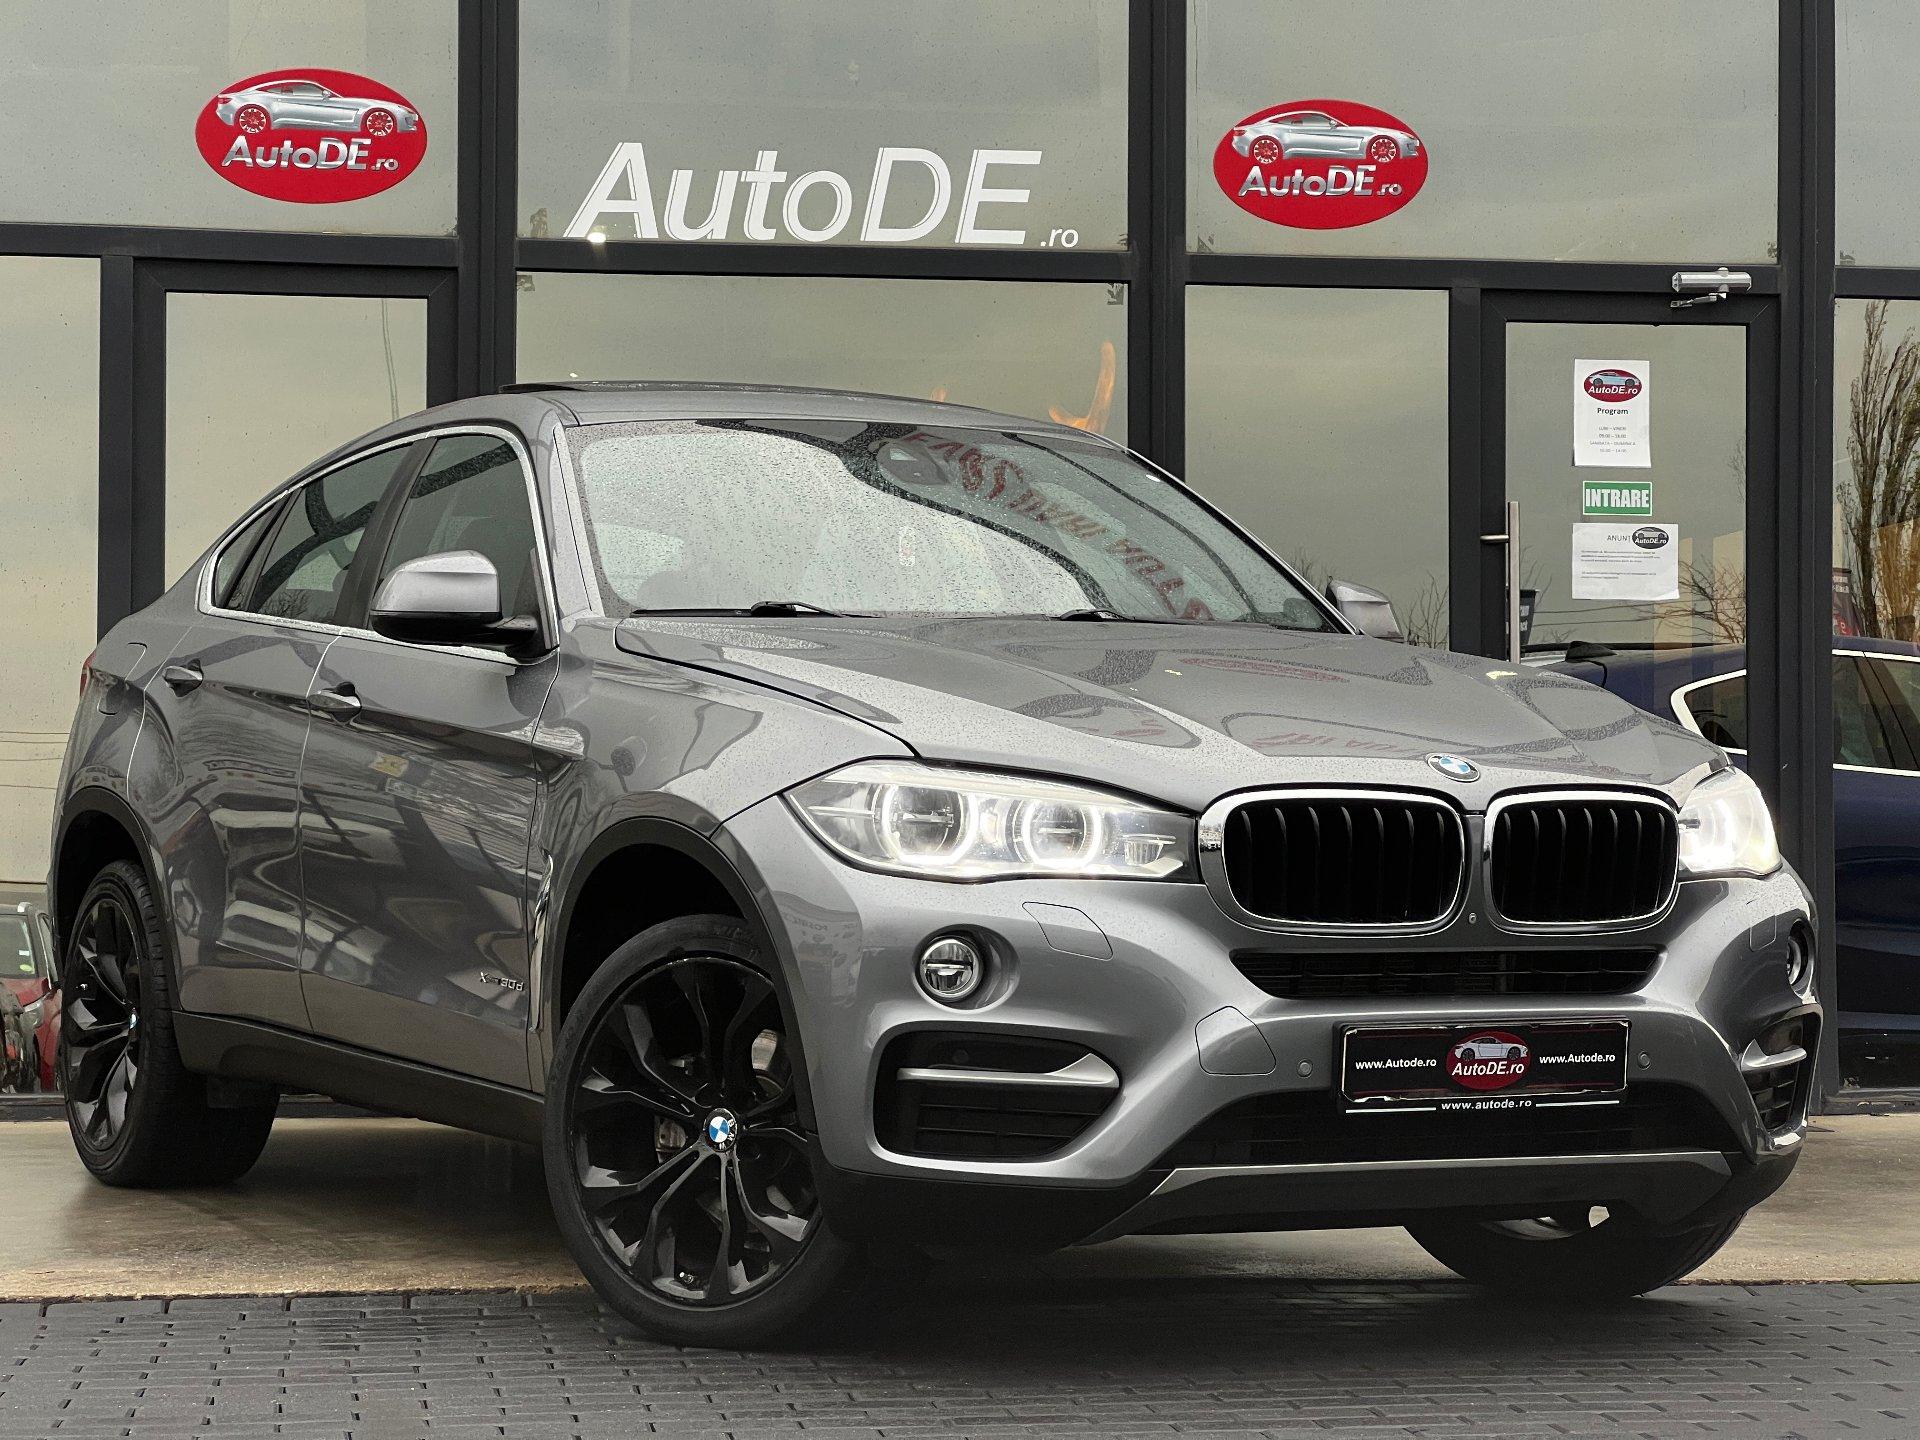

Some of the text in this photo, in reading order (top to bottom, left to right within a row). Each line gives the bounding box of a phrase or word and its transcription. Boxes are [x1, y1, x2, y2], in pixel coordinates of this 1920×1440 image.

[1588, 386, 1639, 395] AutoDE.ro
[1597, 407, 1629, 415] Program
[1585, 488, 1649, 508] INTRARE
[1355, 1057, 1437, 1070] www.Autode.ro
[1539, 1053, 1616, 1065] www.Autode.ro
[1451, 1061, 1525, 1076] AutoDE.ro
[1441, 1099, 1532, 1110] www.autode.ro
